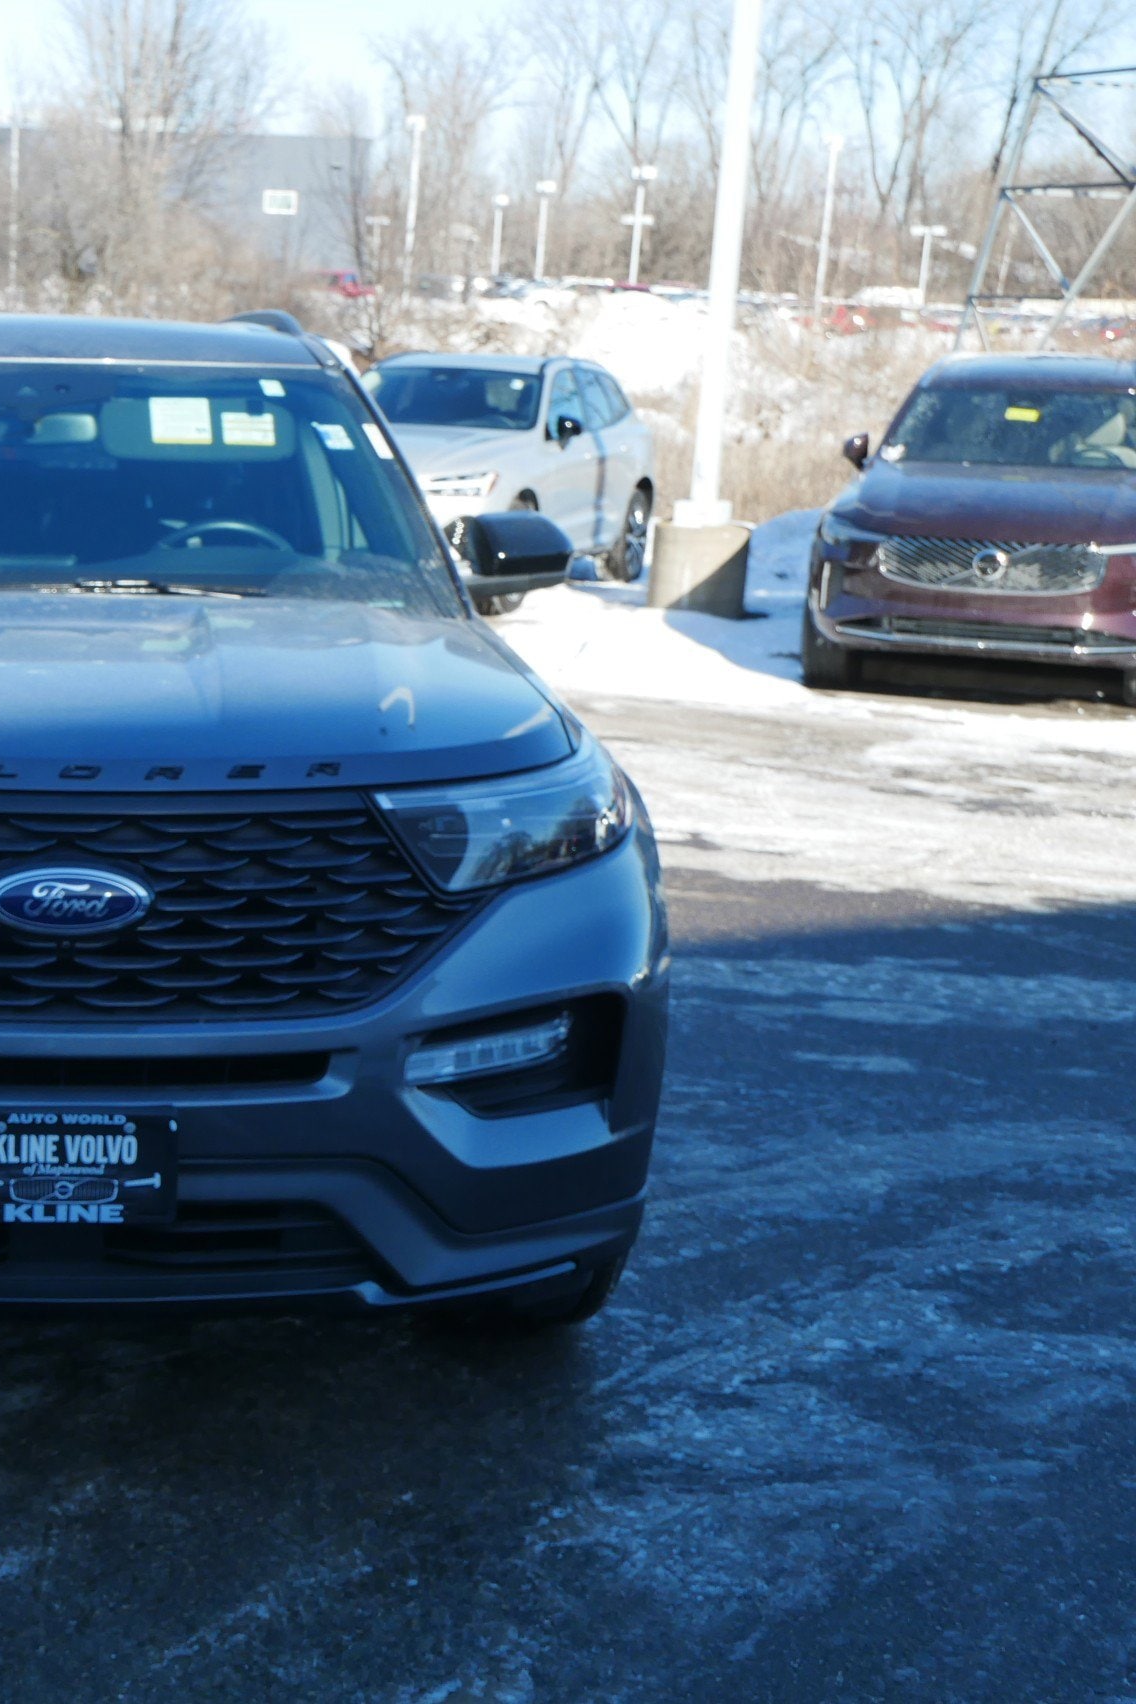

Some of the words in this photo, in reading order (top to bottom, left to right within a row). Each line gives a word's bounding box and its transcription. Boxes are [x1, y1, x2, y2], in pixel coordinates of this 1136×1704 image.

[23, 881, 111, 918] Ford
[7, 1113, 57, 1125] AUTO
[62, 1113, 126, 1125] WORLD
[66, 1134, 138, 1165] VOLVO
[2, 1203, 124, 1223] KLINE
